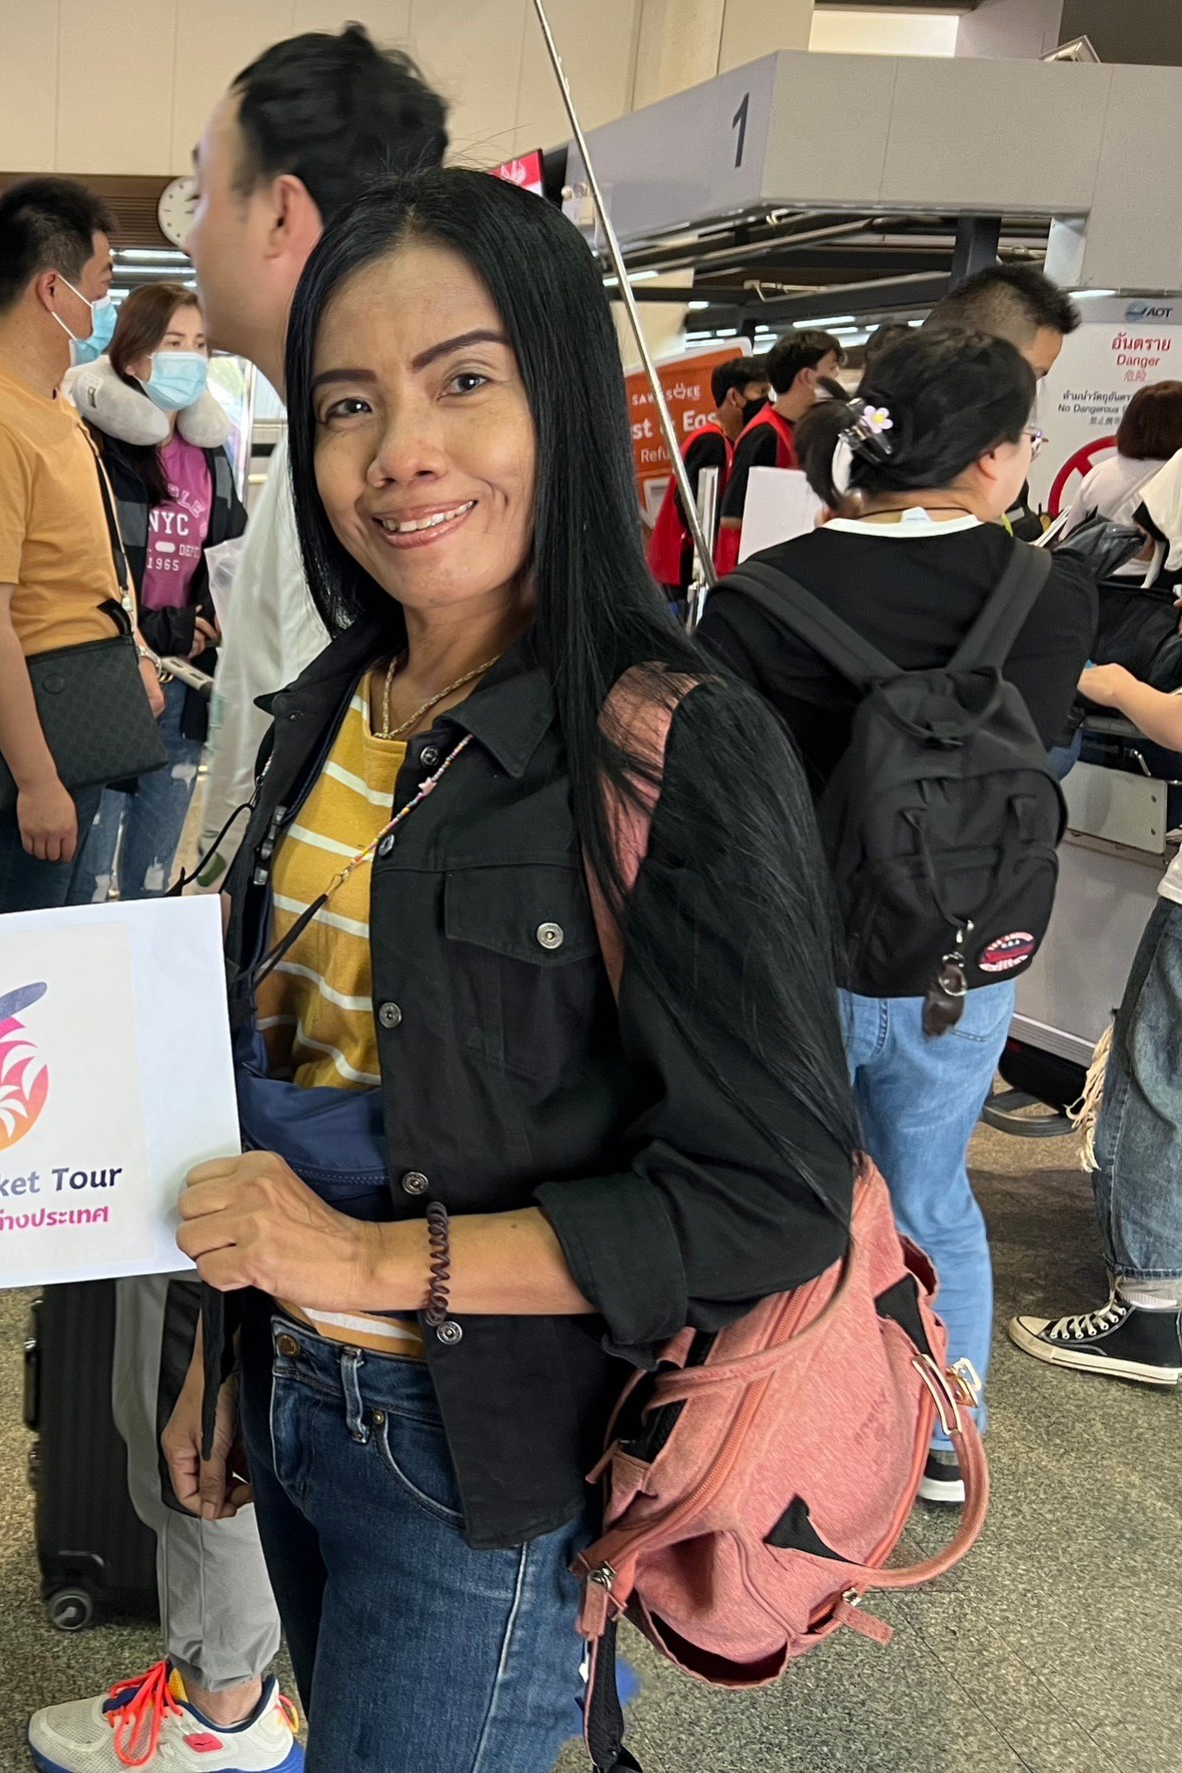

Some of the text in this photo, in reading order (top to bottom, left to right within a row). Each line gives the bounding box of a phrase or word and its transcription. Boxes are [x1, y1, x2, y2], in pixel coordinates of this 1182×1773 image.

[732, 91, 750, 169] 1
[1146, 307, 1174, 318] AOT
[1112, 331, 1172, 352] อันตราย
[1116, 354, 1161, 369] Danger
[1058, 404, 1071, 413] No
[1073, 403, 1119, 415] Dangerous
[631, 416, 654, 440] st
[682, 409, 718, 433] Eas
[640, 446, 672, 464] Refu
[148, 509, 190, 537] NYC
[51, 1166, 123, 1192] Tour
